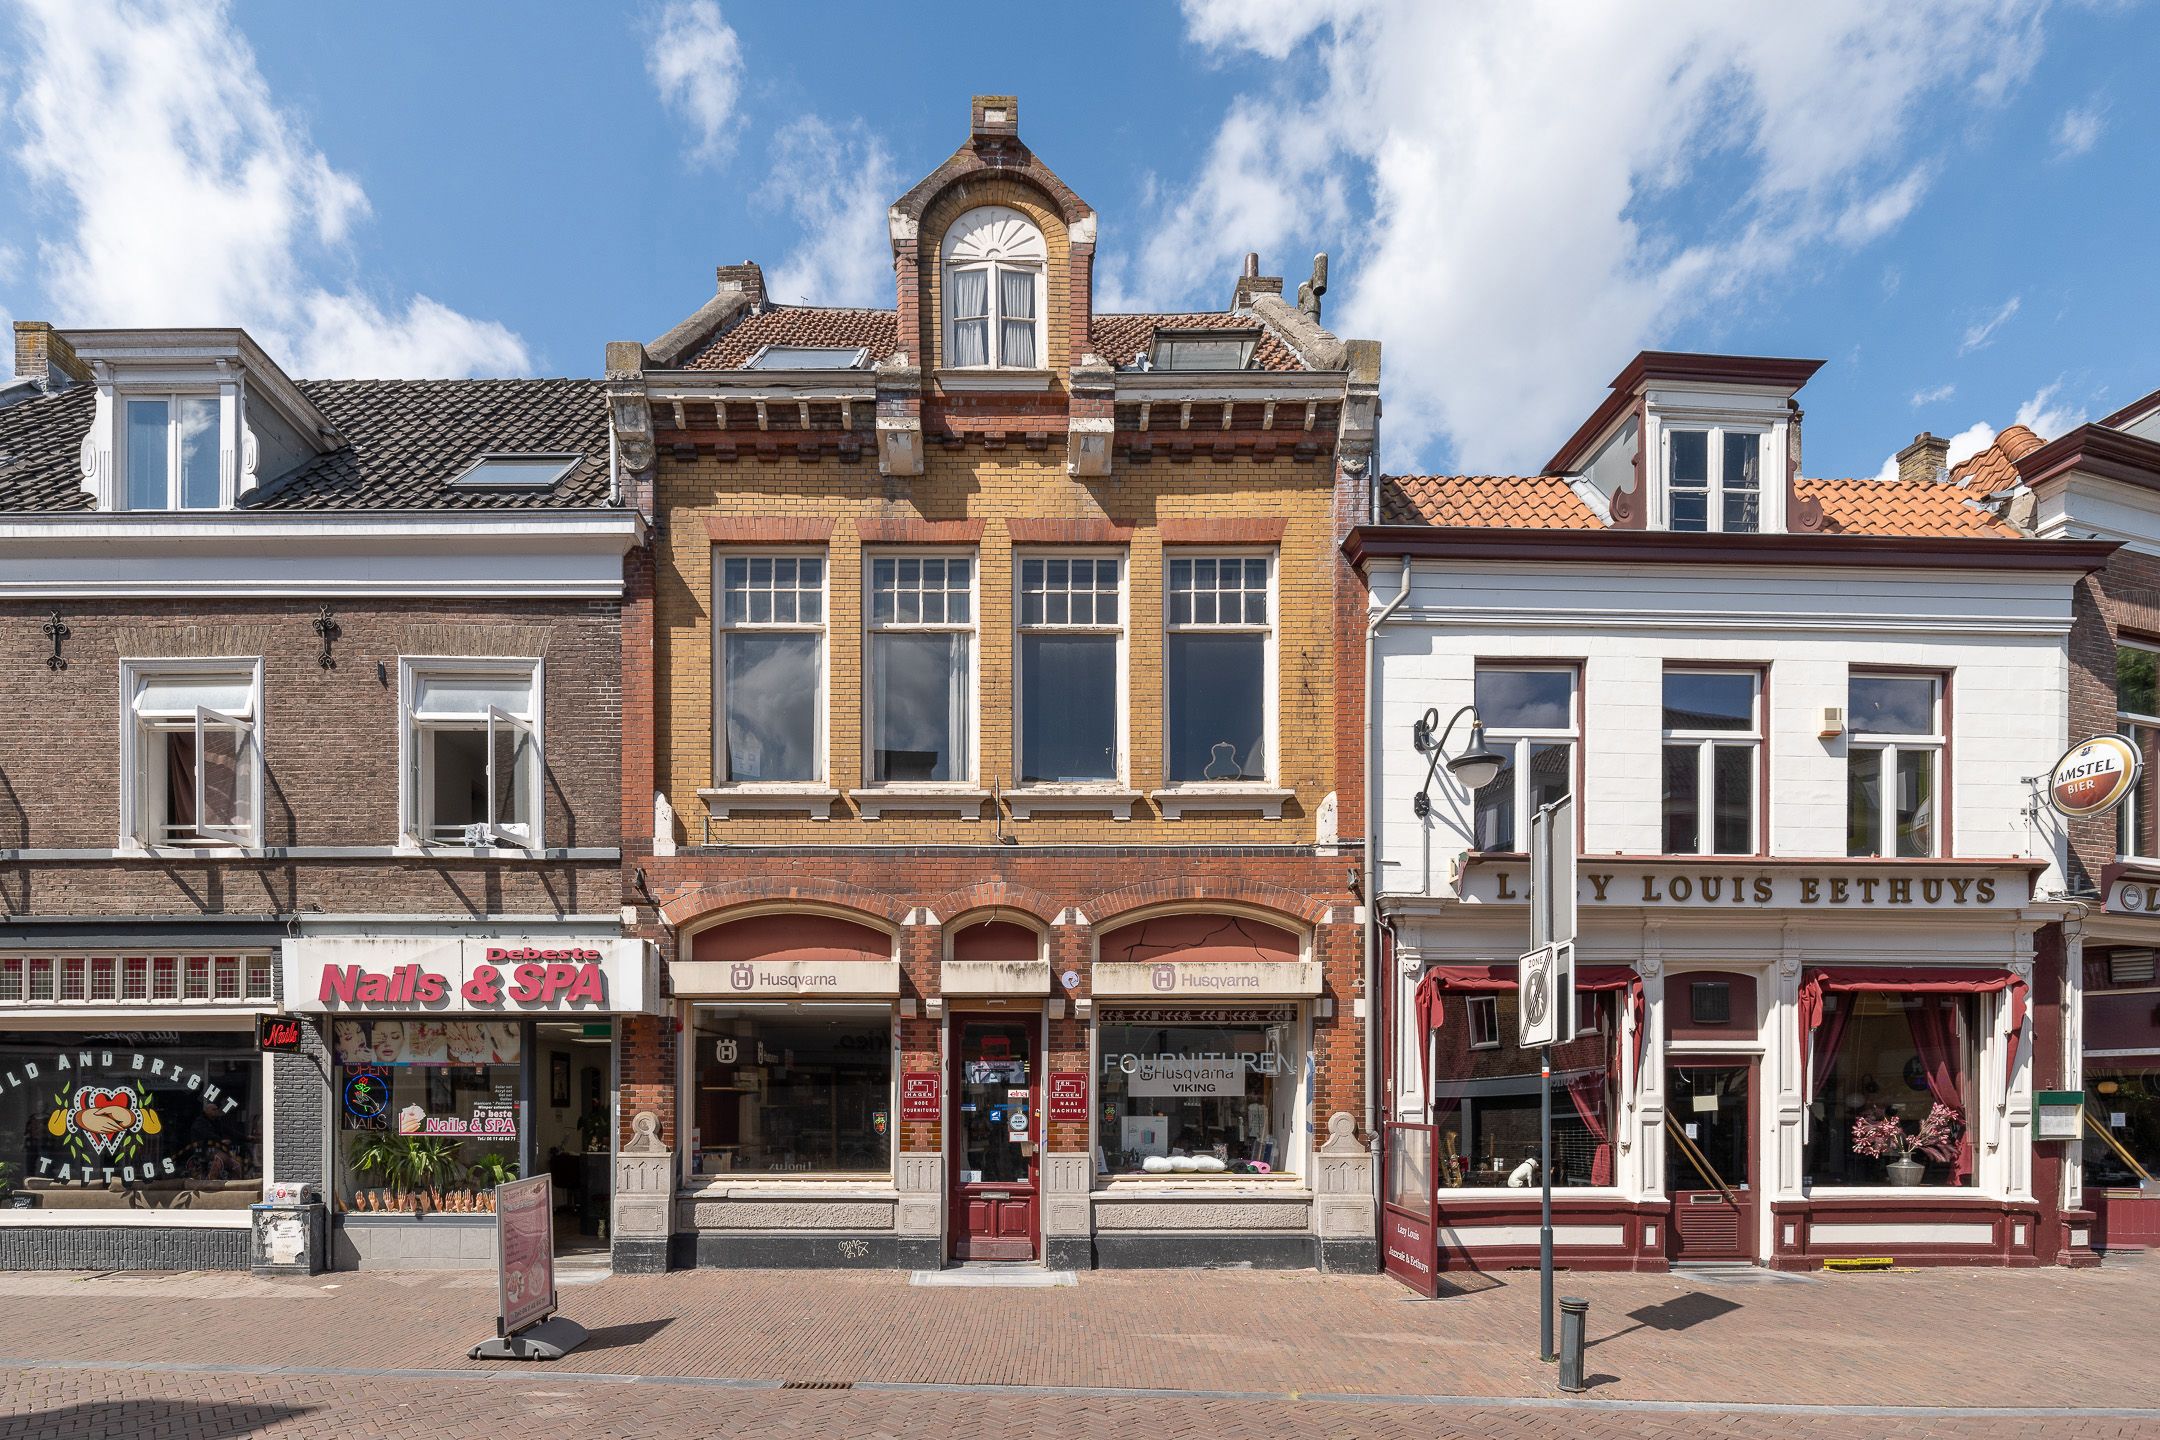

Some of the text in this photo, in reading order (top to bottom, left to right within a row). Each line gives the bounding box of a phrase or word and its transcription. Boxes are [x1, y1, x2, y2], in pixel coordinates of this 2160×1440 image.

[2057, 758, 2115, 785] AMSTEL
[2067, 780, 2096, 795] BIER
[1496, 873, 1997, 904] LY LOUIS EETHUYS
[486, 947, 600, 961] Debeste
[1528, 955, 1544, 969] ZONE
[319, 963, 605, 1004] Nails & SPA
[760, 973, 837, 988] Husqvarna
[1181, 974, 1260, 989] Husqvarna
[263, 1022, 299, 1047] Nails
[346, 1065, 389, 1076] OPEN
[1104, 1053, 1296, 1075] FOURNITUREN
[58, 1050, 113, 1071] AND
[131, 1053, 239, 1115] BRIGHT
[1154, 1064, 1234, 1083] Husqvarna
[1172, 1083, 1216, 1093] VIKING
[344, 1112, 387, 1130] NAILS
[473, 1110, 513, 1118] De beste
[427, 1117, 517, 1133] Nails & SPA
[39, 1156, 176, 1183] TATTOOS
[1397, 1223, 1420, 1241] Lazy Louis
